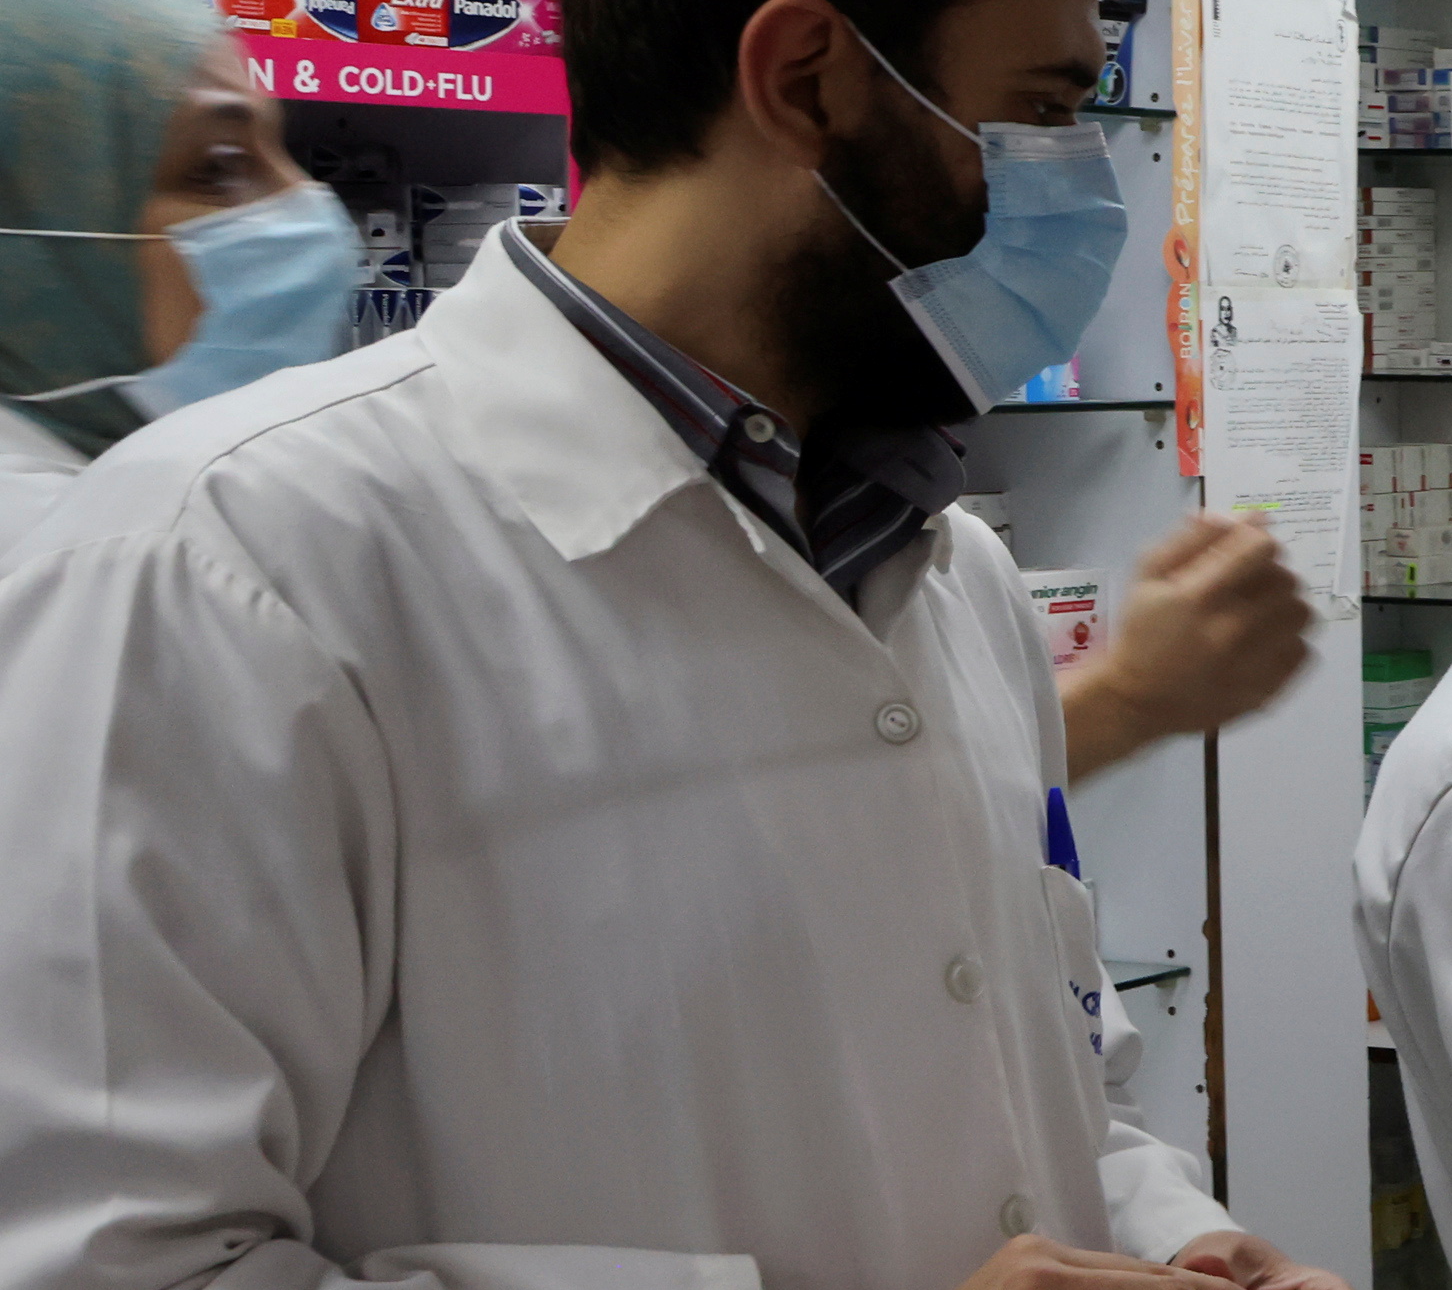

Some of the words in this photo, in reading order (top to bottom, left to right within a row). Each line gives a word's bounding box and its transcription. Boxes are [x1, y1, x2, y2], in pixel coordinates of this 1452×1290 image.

[293, 60, 321, 94] &
[338, 67, 493, 102] COLD+FLU
[1177, 282, 1194, 359] BOIRON
